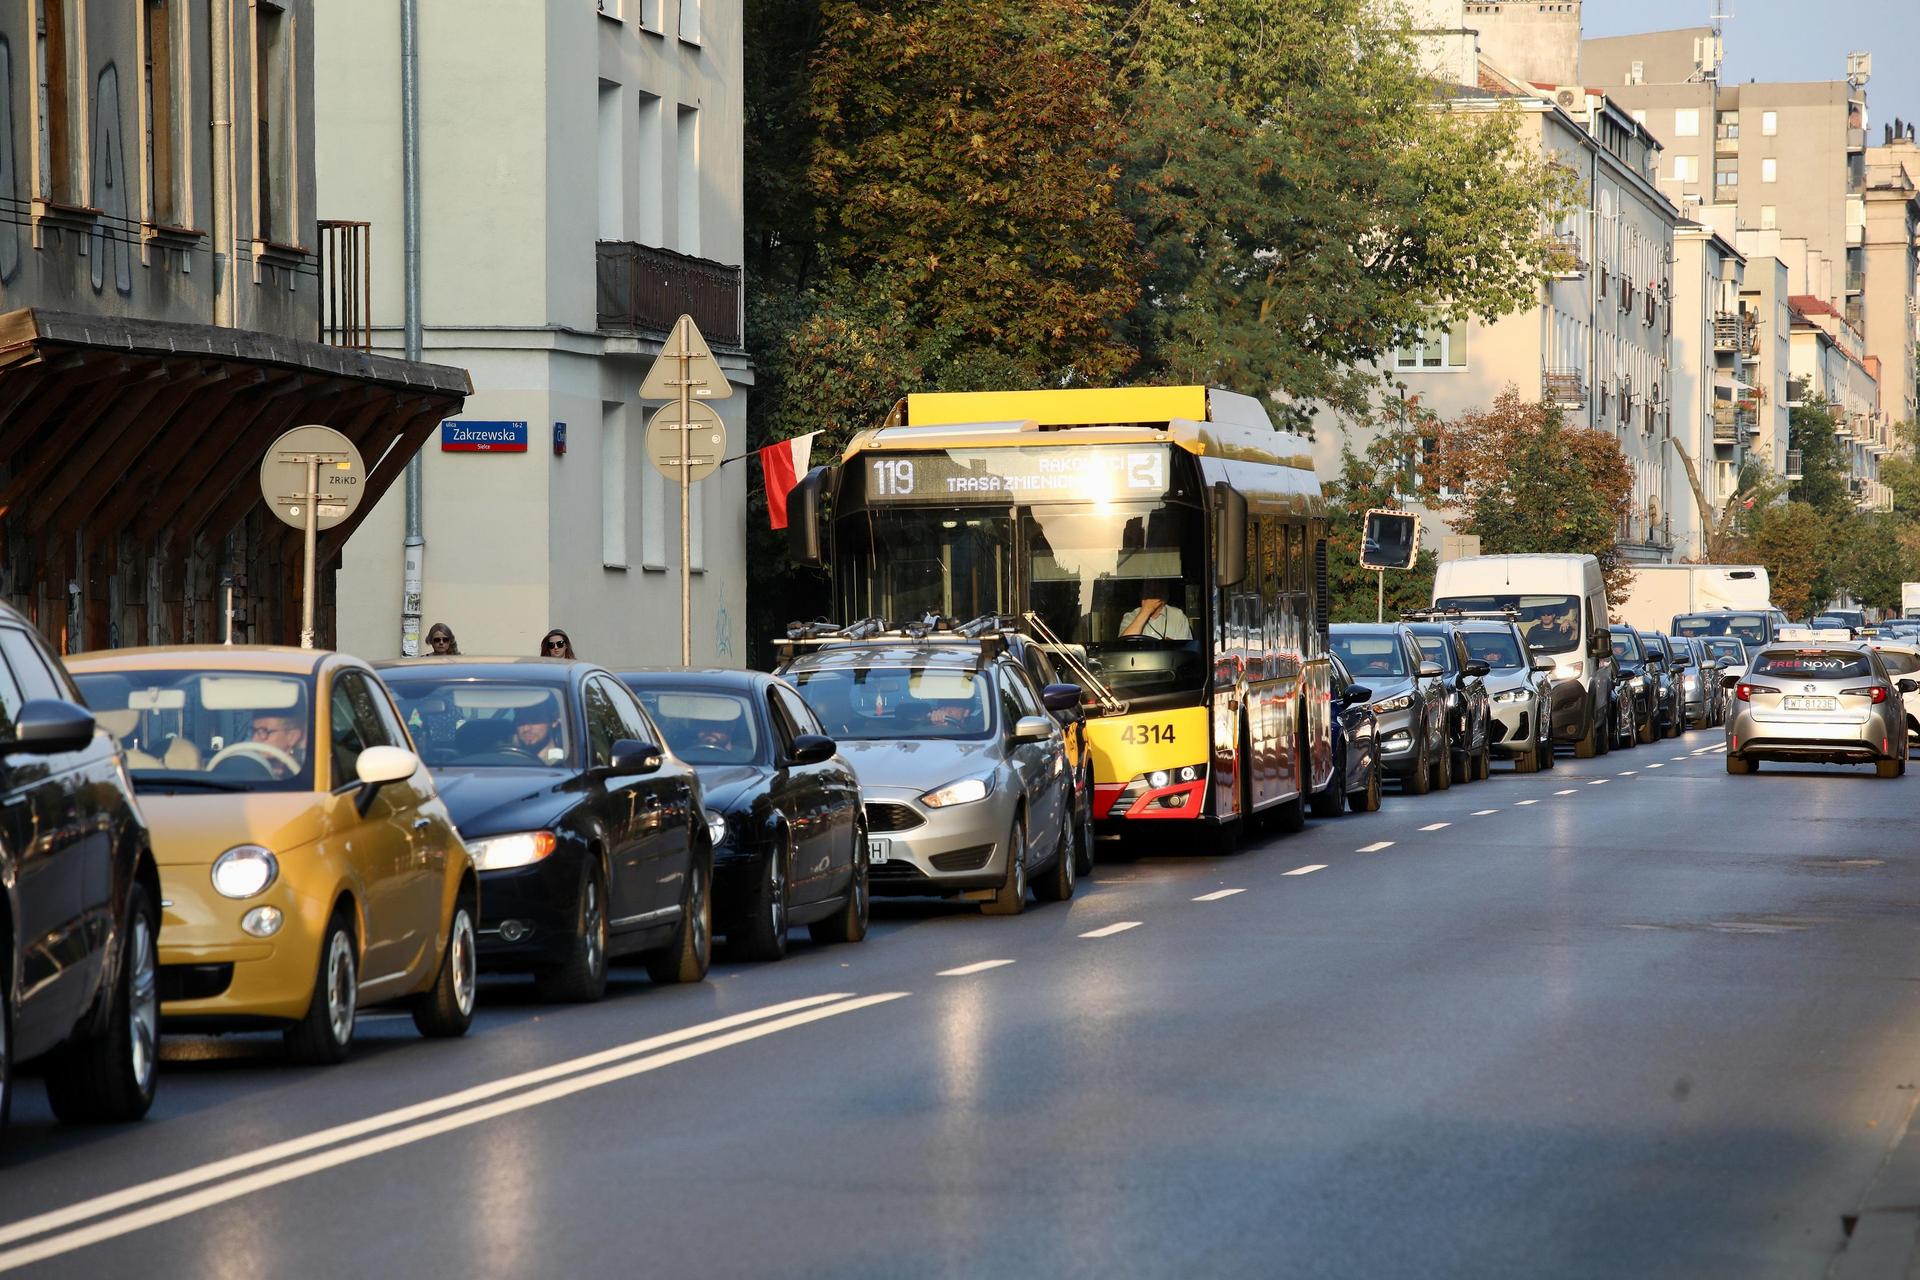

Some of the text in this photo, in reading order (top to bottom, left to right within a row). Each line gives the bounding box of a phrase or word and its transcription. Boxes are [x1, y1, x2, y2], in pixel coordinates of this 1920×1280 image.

[453, 428, 515, 441] Zakrzewska
[873, 459, 913, 494] 119
[947, 476, 1001, 492] TRASA
[1121, 724, 1176, 744] 4314
